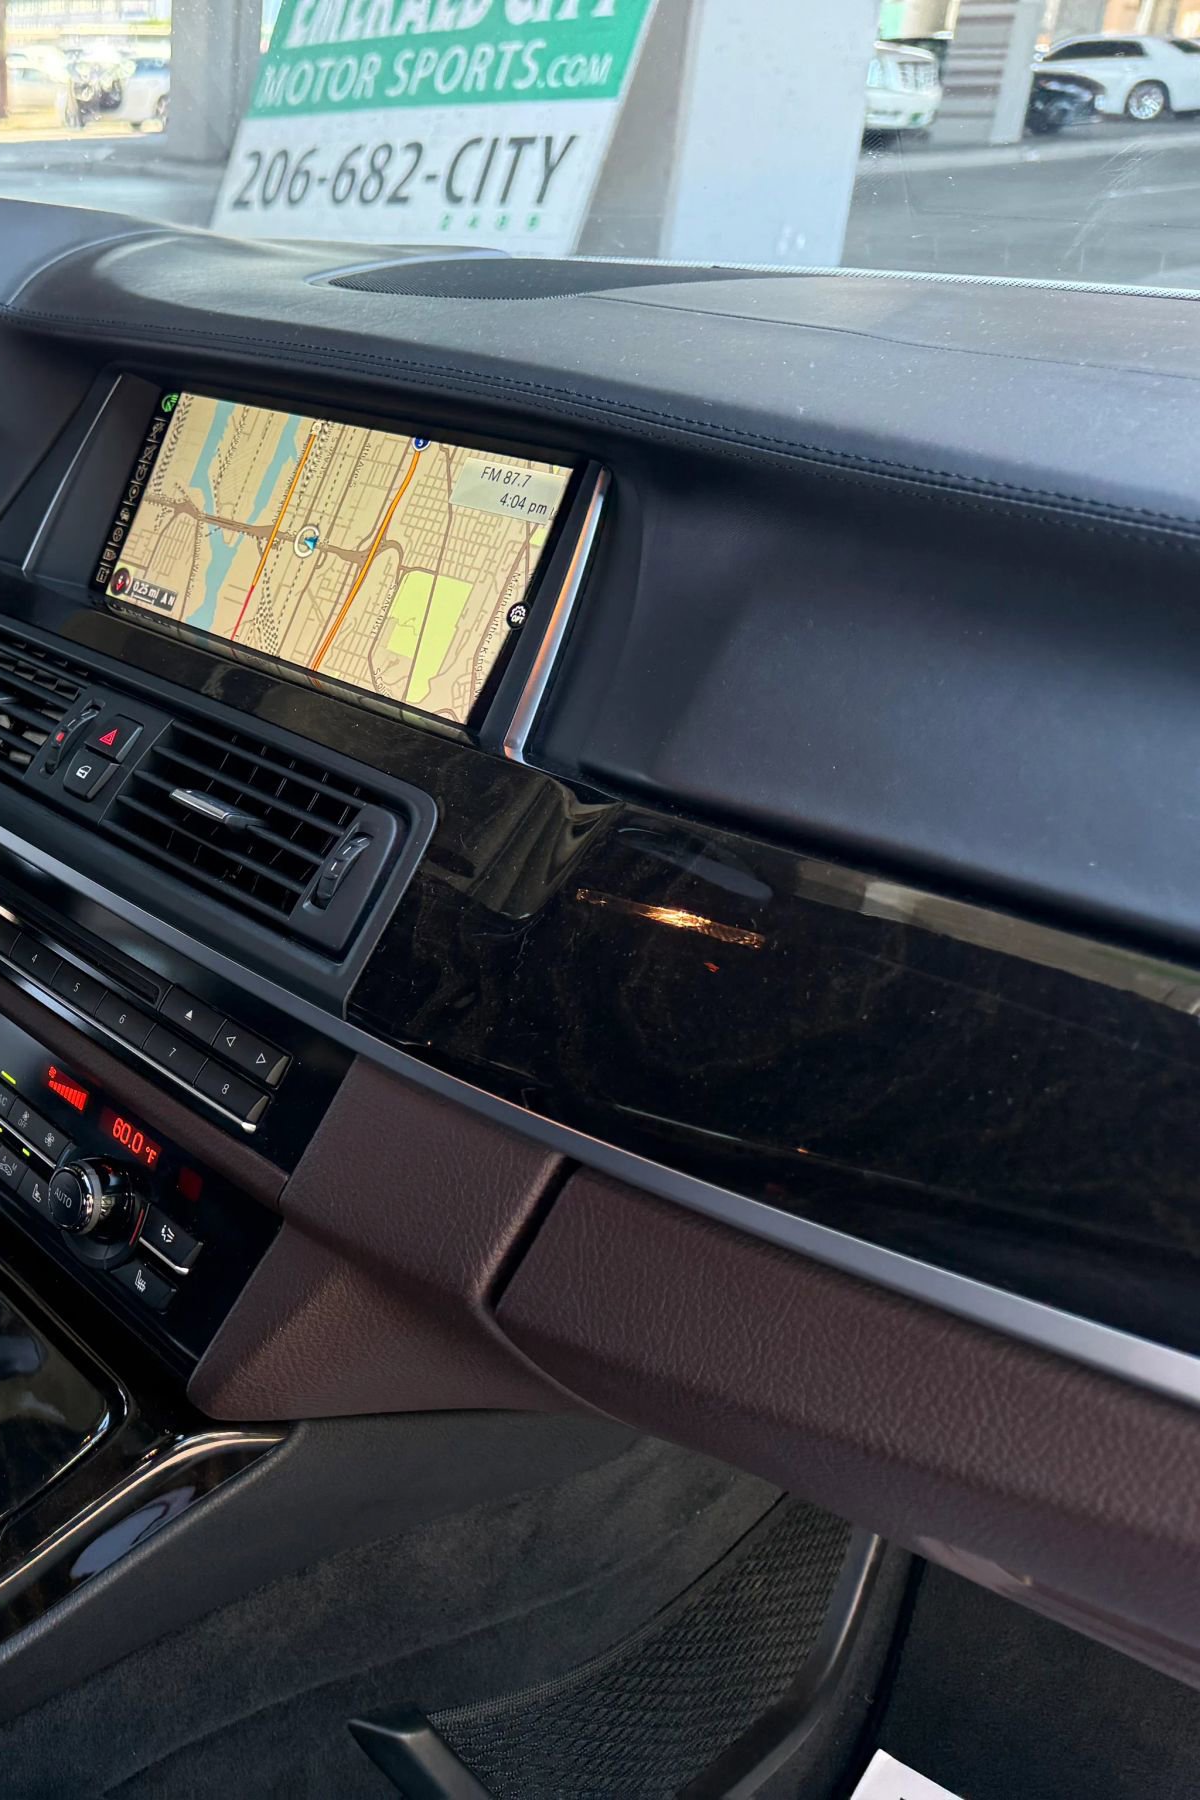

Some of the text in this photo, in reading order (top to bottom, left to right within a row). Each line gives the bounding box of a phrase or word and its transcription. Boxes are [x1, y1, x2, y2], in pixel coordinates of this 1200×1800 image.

[255, 54, 380, 107] MOTOR
[232, 135, 576, 209] 206-682-CITY
[480, 466, 532, 488] FM 87.7
[500, 493, 548, 515] 4:04 pm
[132, 580, 148, 595] 0.25
[148, 588, 160, 599] mi
[501, 572, 521, 607] Martin
[370, 615, 384, 635] 15th
[381, 593, 392, 612] Ave
[484, 610, 504, 644] Luther
[31, 953, 38, 964] 4
[73, 982, 81, 993] 5
[118, 1014, 127, 1024] 6
[169, 1047, 177, 1057] 7
[221, 1083, 230, 1095] 8
[17, 1119, 28, 1129] OFF
[112, 1117, 144, 1154] 60.0
[54, 1188, 72, 1209] AUTO
